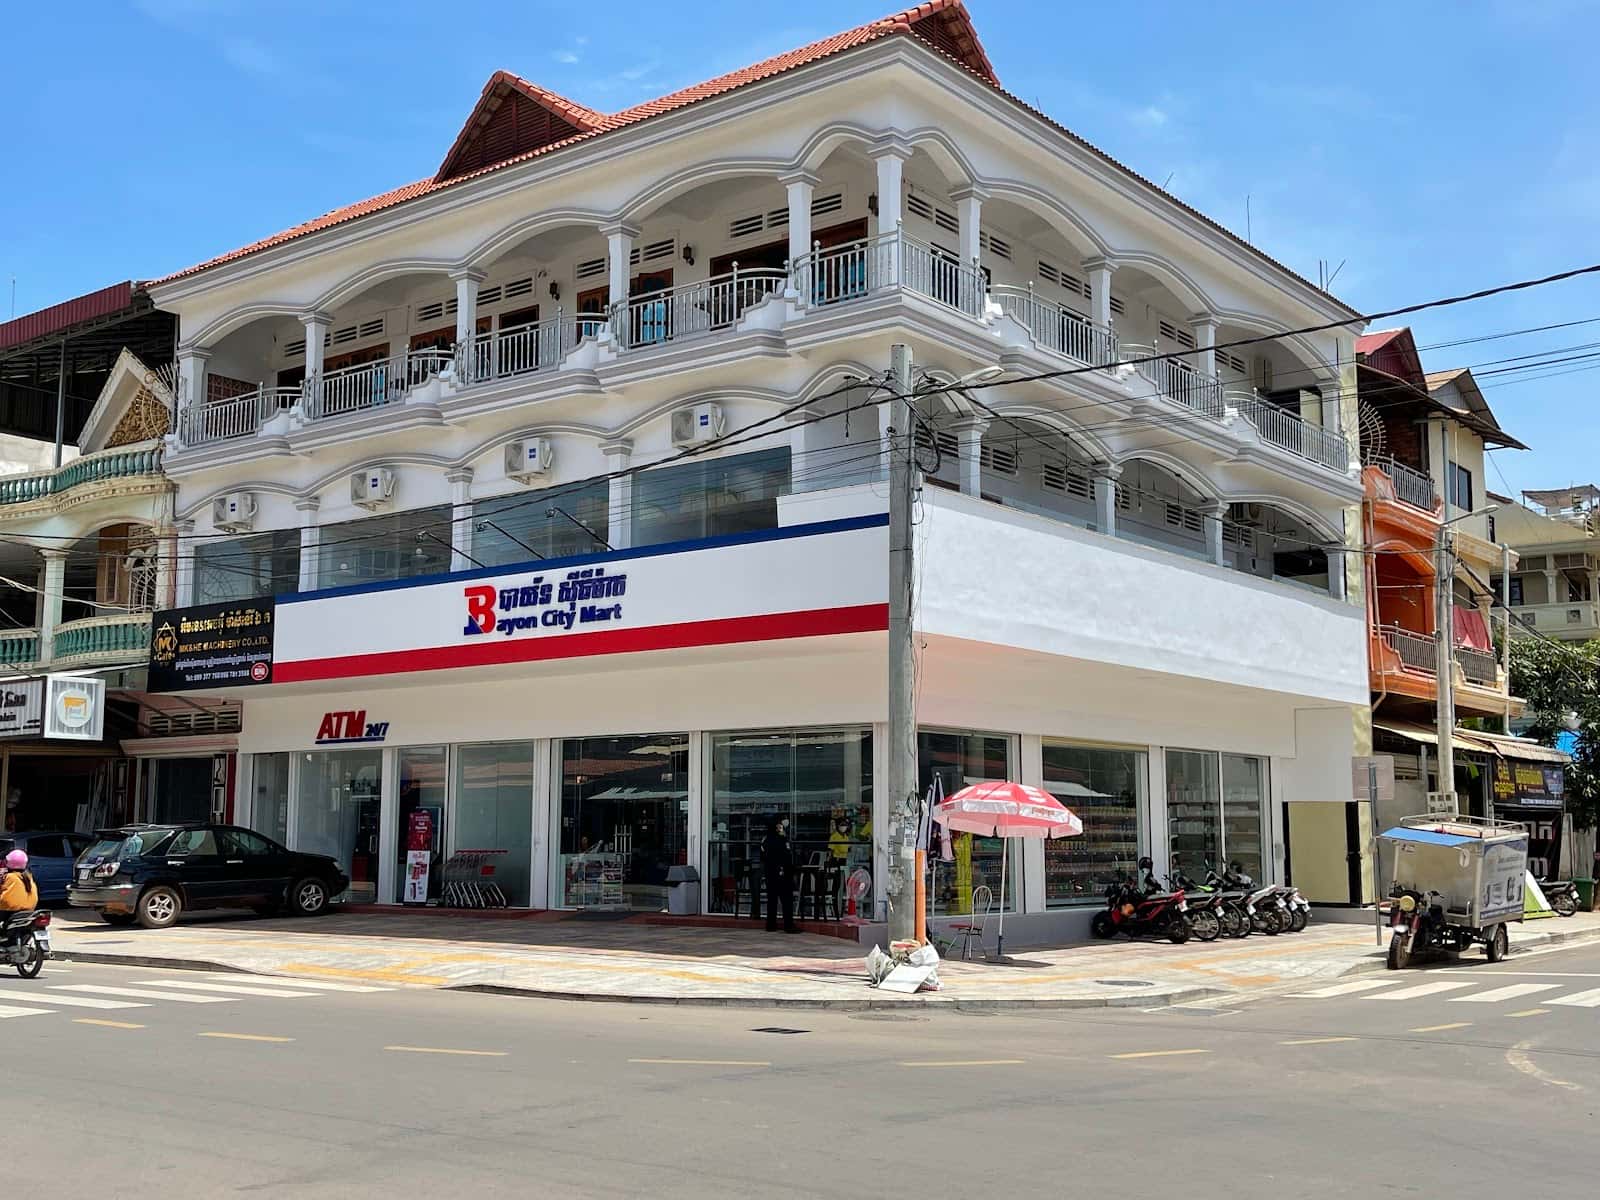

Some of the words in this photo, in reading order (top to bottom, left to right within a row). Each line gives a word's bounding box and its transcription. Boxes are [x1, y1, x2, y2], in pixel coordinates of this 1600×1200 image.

[464, 585, 537, 635] Bayon
[541, 609, 575, 629] City
[580, 603, 621, 623] Mart
[203, 640, 240, 650] MACHINERY
[316, 710, 367, 740] ATM
